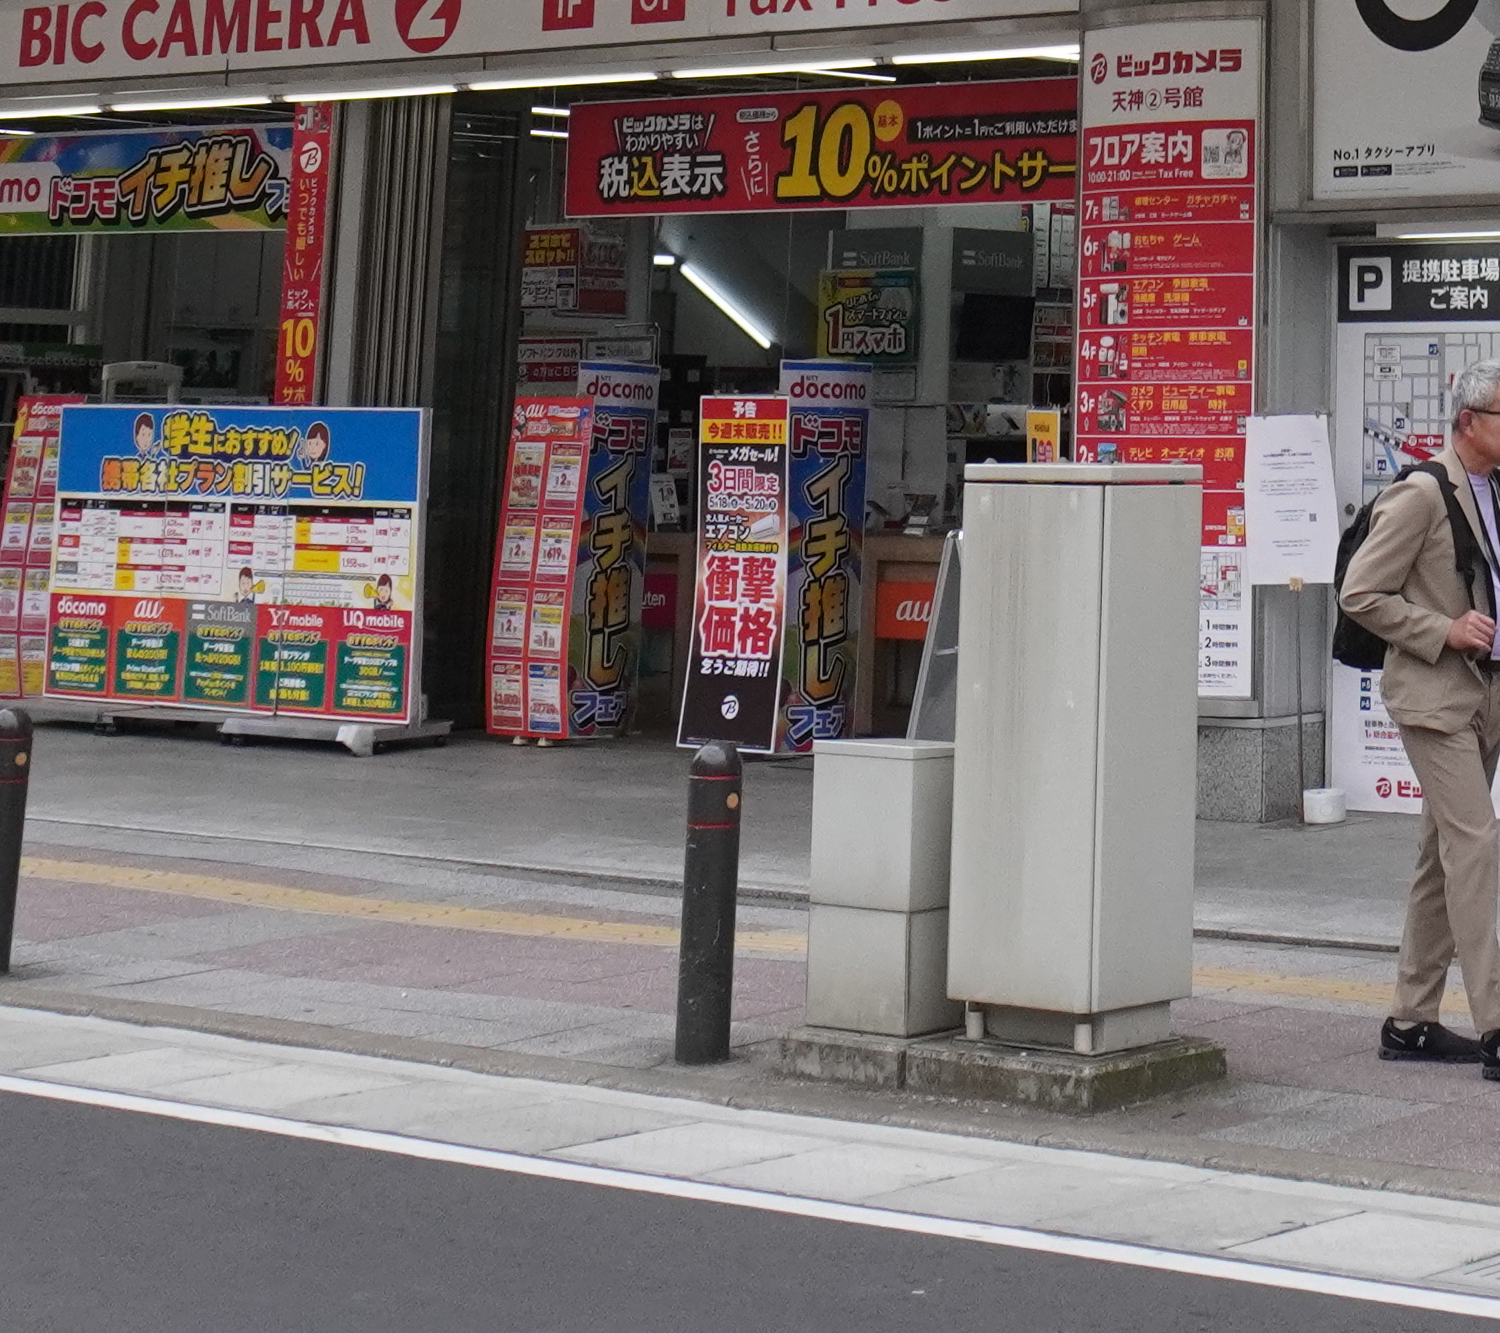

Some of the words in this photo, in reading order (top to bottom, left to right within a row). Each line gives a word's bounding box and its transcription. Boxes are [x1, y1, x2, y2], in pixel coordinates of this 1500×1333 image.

[18, 1, 107, 69] BIC
[1117, 49, 1242, 78] ビックカメラ
[622, 114, 703, 132] ビックカメラは
[625, 134, 699, 151] わかりやすい
[1090, 131, 1193, 167] フロア案内
[1334, 148, 1359, 161] No.1
[1364, 144, 1435, 159] タクシーアプリ
[600, 153, 724, 198] 税込表示
[1159, 169, 1172, 178] Tax
[1175, 169, 1193, 178] Free
[1085, 200, 1099, 220] 7F
[1084, 238, 1099, 256] 6F
[1083, 289, 1097, 308] 5F
[1429, 286, 1490, 310] ご案内
[1081, 340, 1096, 360] 4F
[587, 375, 653, 400] docomo
[790, 375, 866, 400] docomo
[1080, 392, 1095, 411] 3F
[1131, 386, 1153, 396] カメラ
[733, 402, 757, 418] 予告
[163, 414, 299, 455] 学生におすすめ!
[708, 423, 782, 439] 今週末販売!!
[1130, 447, 1153, 458] テレビ
[102, 460, 363, 496] 携帯各社プラン割引サービス!
[706, 525, 750, 540] エアコン
[705, 555, 777, 604] 衝撃
[57, 596, 106, 616] docomo
[134, 600, 164, 618] au
[207, 604, 250, 622] SoftBank
[701, 606, 777, 657] 価格
